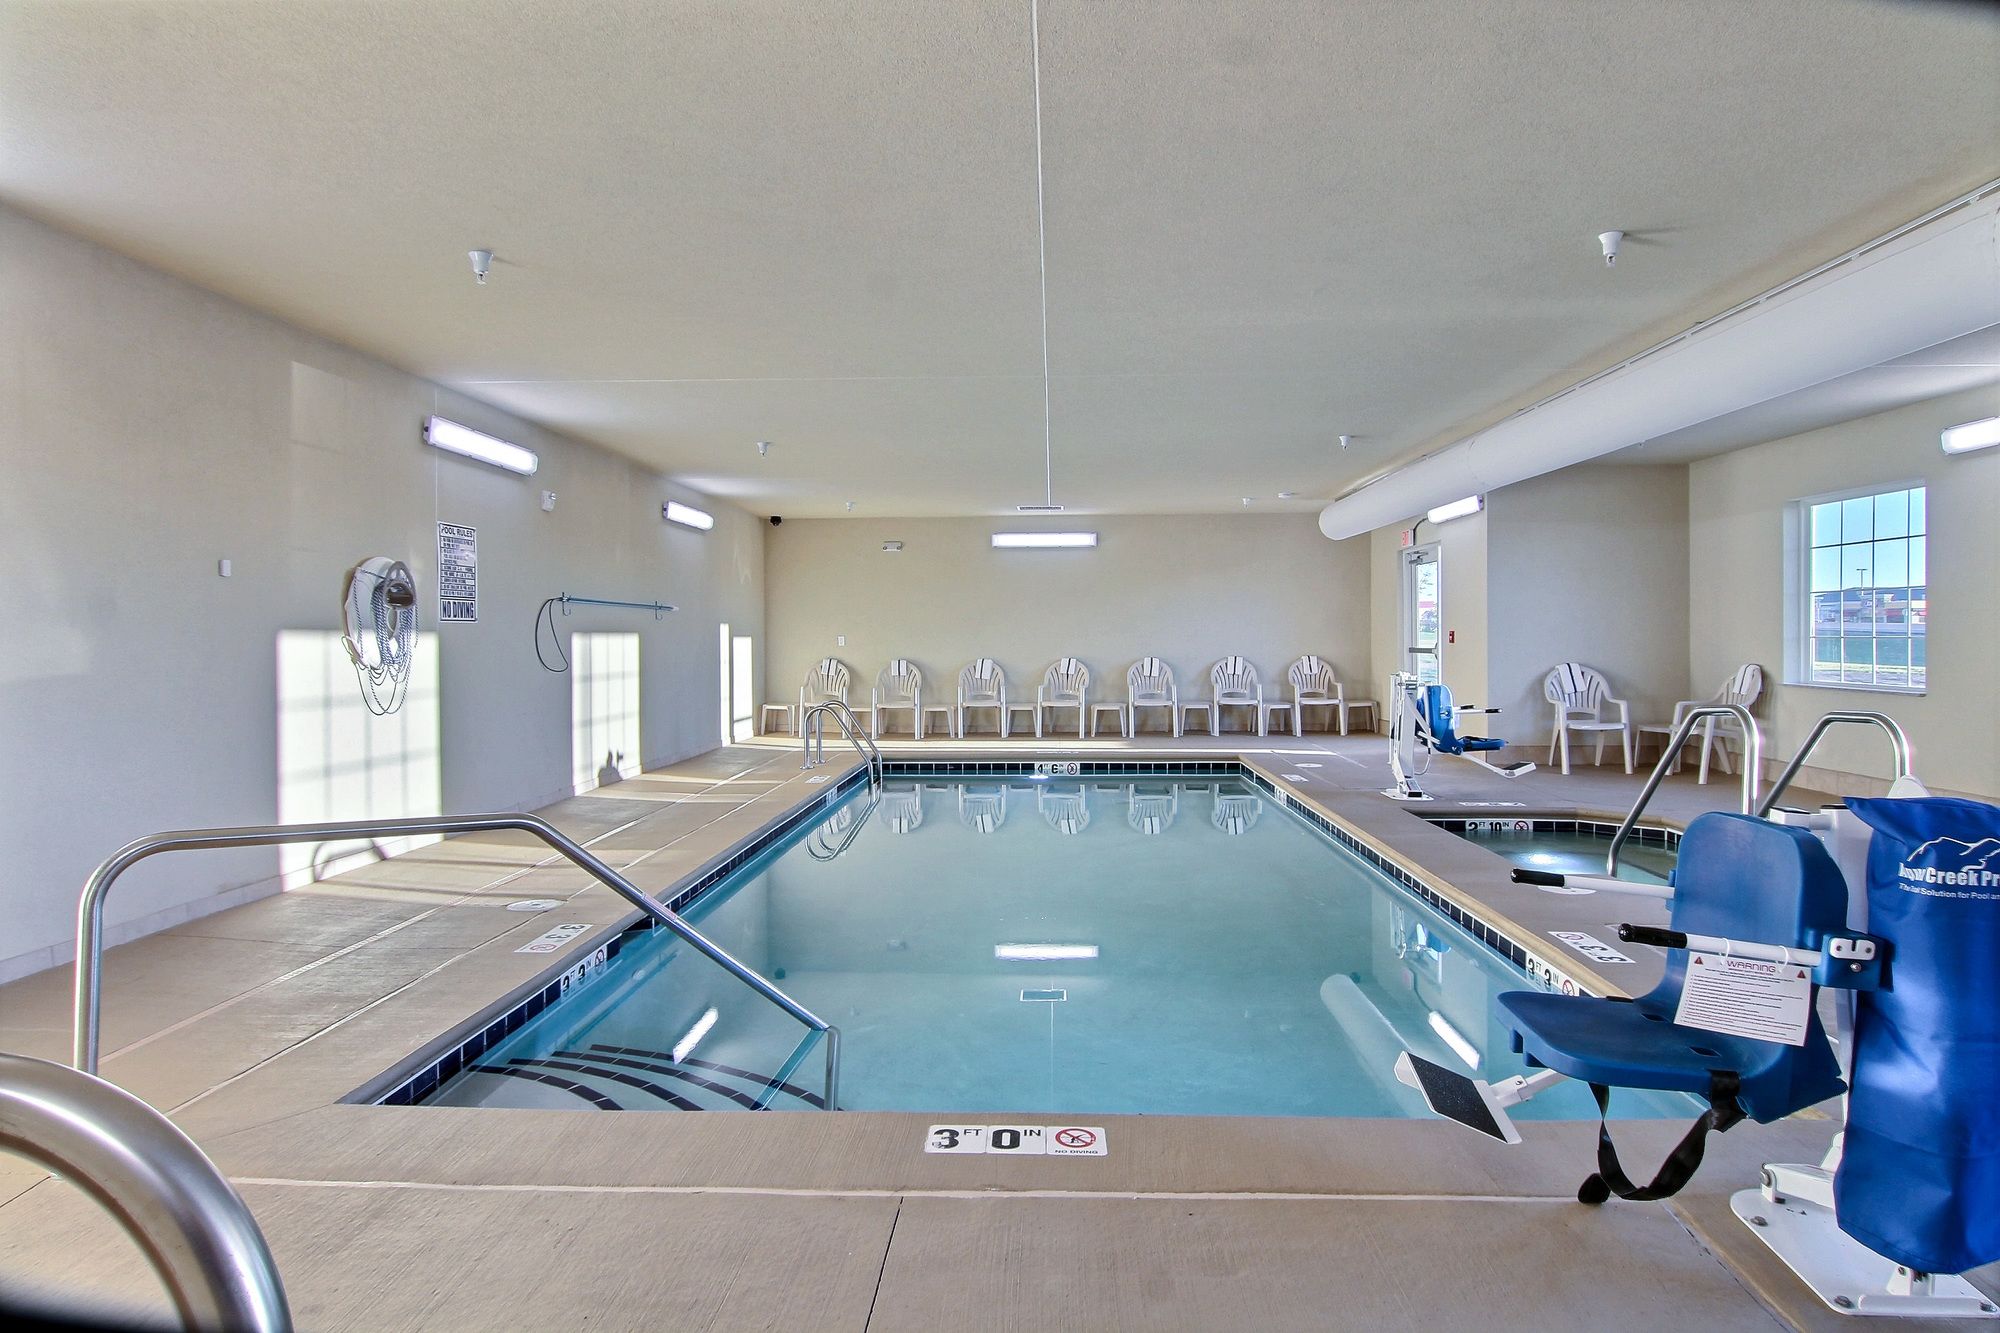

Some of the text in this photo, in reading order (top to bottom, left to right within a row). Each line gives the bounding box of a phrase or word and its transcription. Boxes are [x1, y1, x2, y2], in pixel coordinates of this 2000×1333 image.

[441, 525, 473, 538] POOL RULES
[442, 600, 474, 619] NO DIVING
[1489, 821, 1502, 831] 10
[1920, 887, 1957, 898] Solution
[1957, 891, 1970, 899] for
[1970, 891, 1990, 900] Pool
[1726, 960, 1776, 973] WARNING
[931, 1128, 1041, 1150] 3 FT 0 IN
